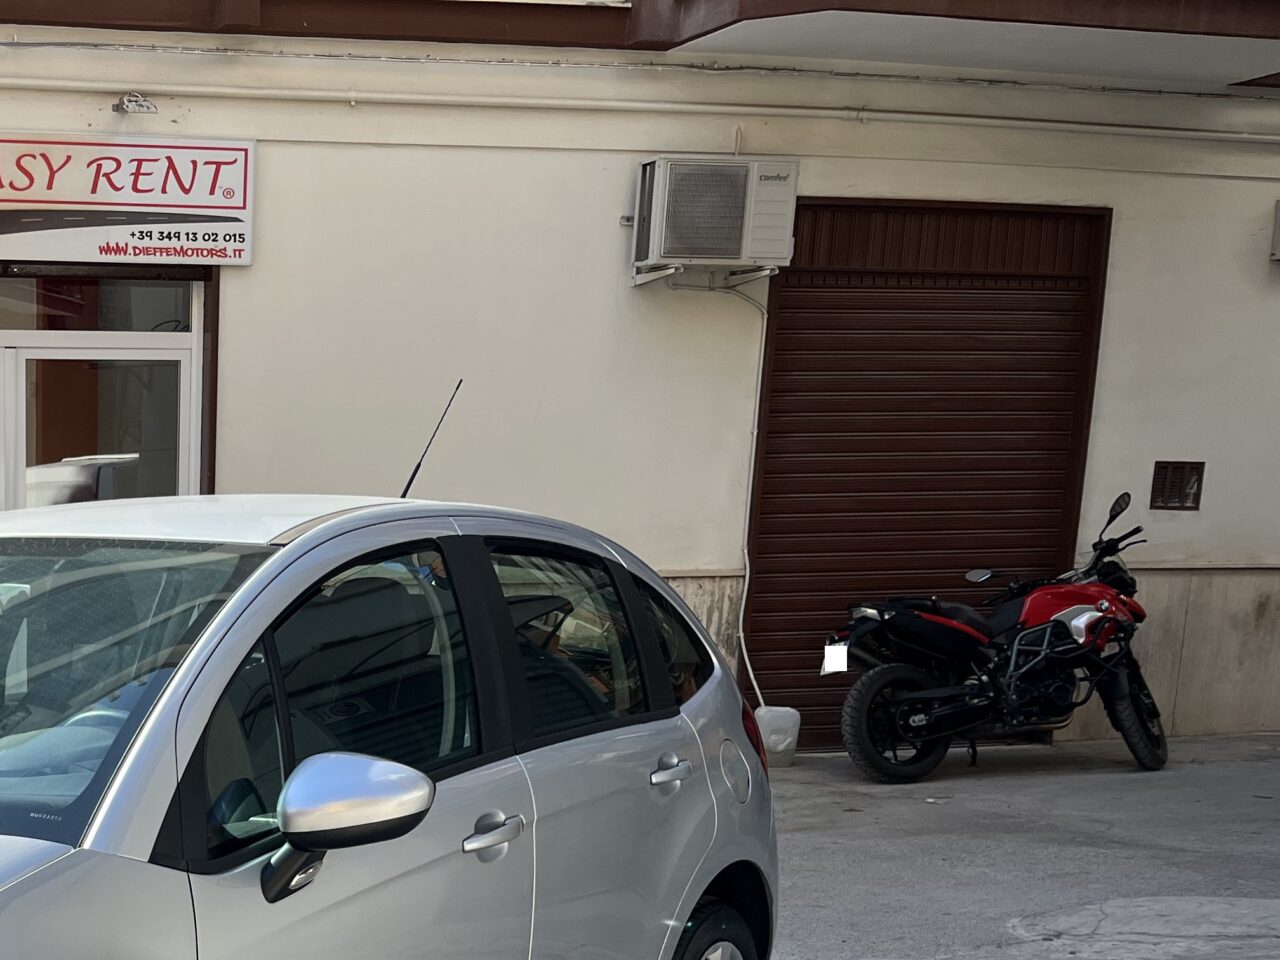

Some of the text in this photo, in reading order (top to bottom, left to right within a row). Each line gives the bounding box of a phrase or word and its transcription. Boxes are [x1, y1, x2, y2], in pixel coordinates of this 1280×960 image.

[130, 230, 246, 243] +39 349 13 02 015
